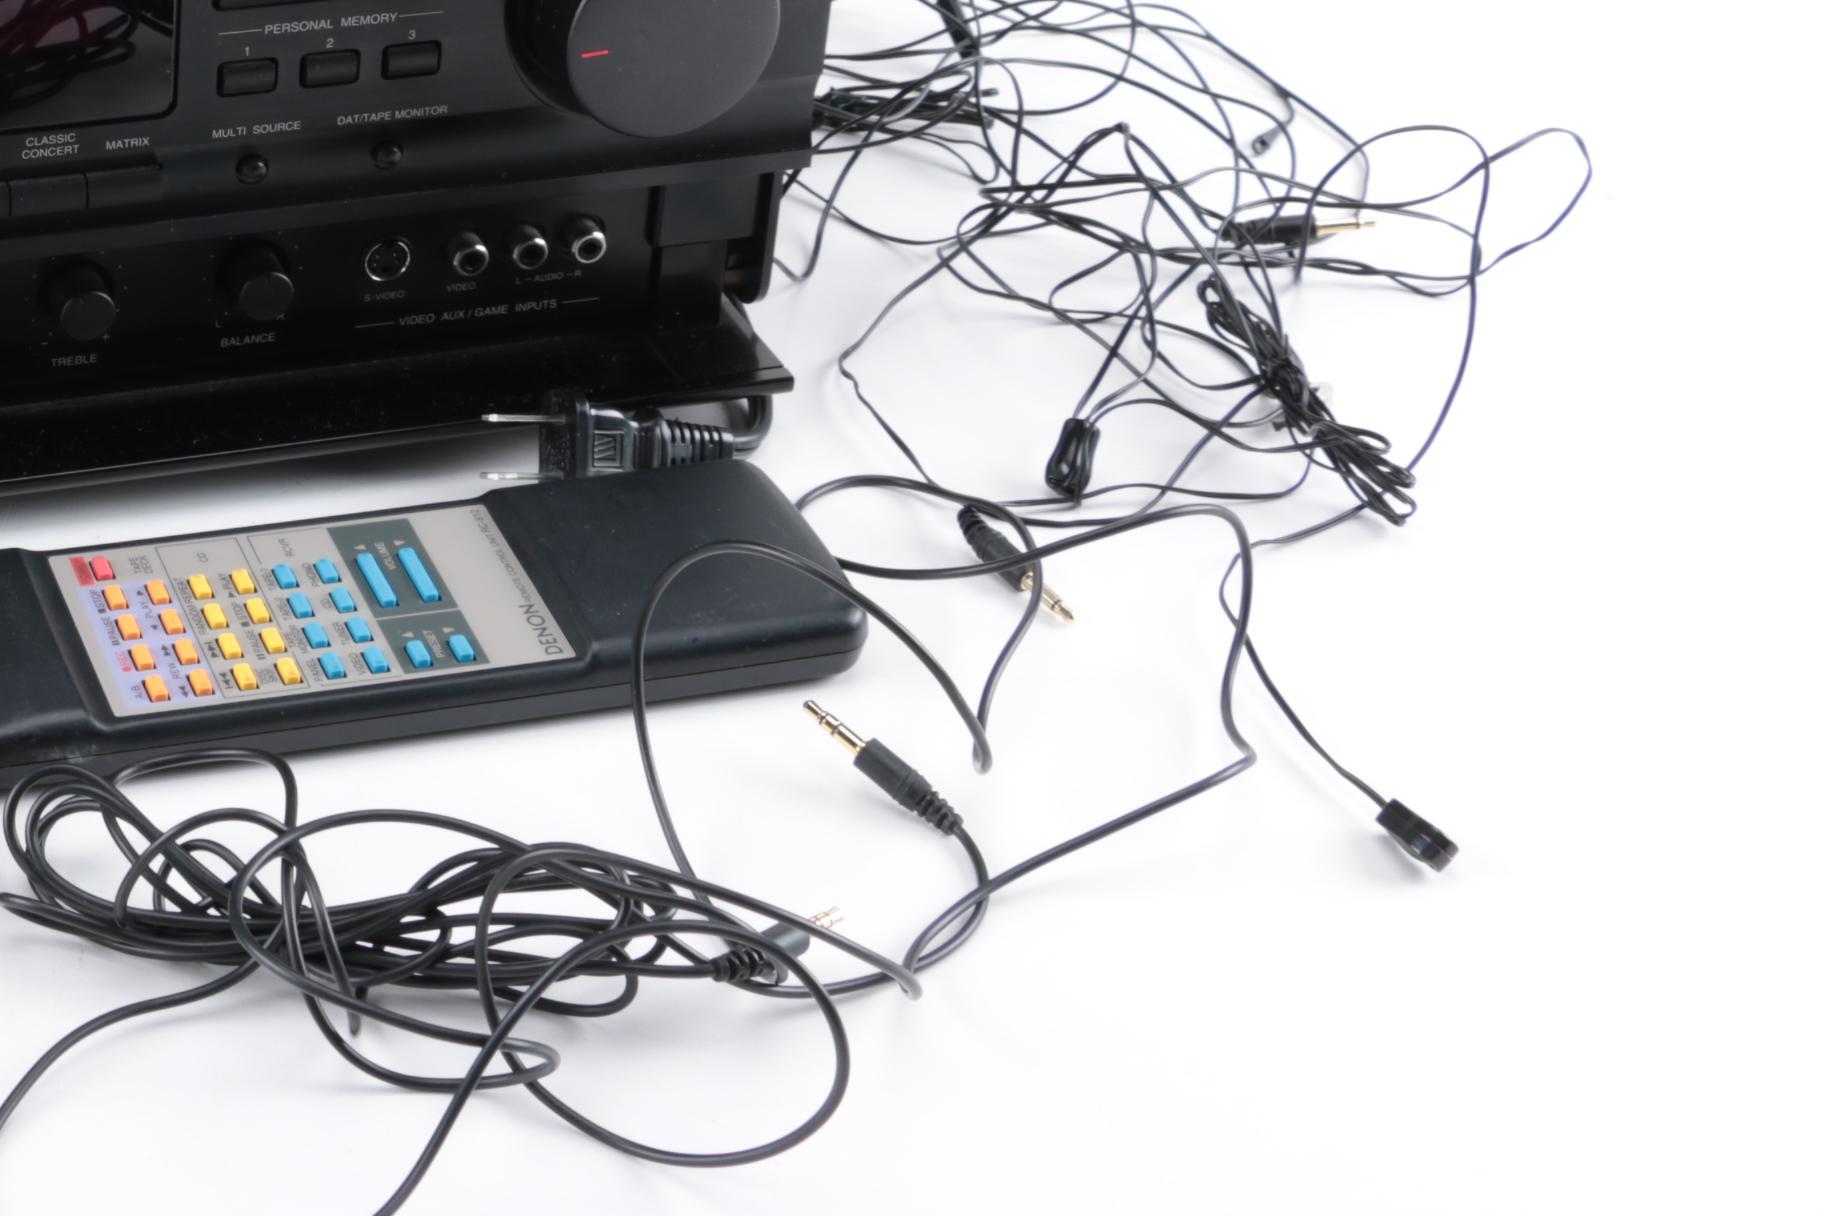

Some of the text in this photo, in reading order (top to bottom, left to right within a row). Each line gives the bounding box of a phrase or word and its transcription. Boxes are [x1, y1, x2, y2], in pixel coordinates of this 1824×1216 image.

[264, 12, 398, 35] PERSONAL MEMORY
[245, 29, 416, 56] 1 2 3
[336, 104, 448, 126] DAT/TAPE MONITOR
[25, 132, 76, 147] CLASSIC
[212, 121, 301, 140] MULTI SOURCE
[21, 144, 79, 160] CONCERT
[105, 136, 150, 151] MATRIX
[399, 313, 435, 327] VIDEO
[515, 299, 558, 313] INPUTS
[220, 332, 275, 347] BALANCE
[50, 353, 97, 368] TREBLE
[519, 602, 563, 657] DENON
